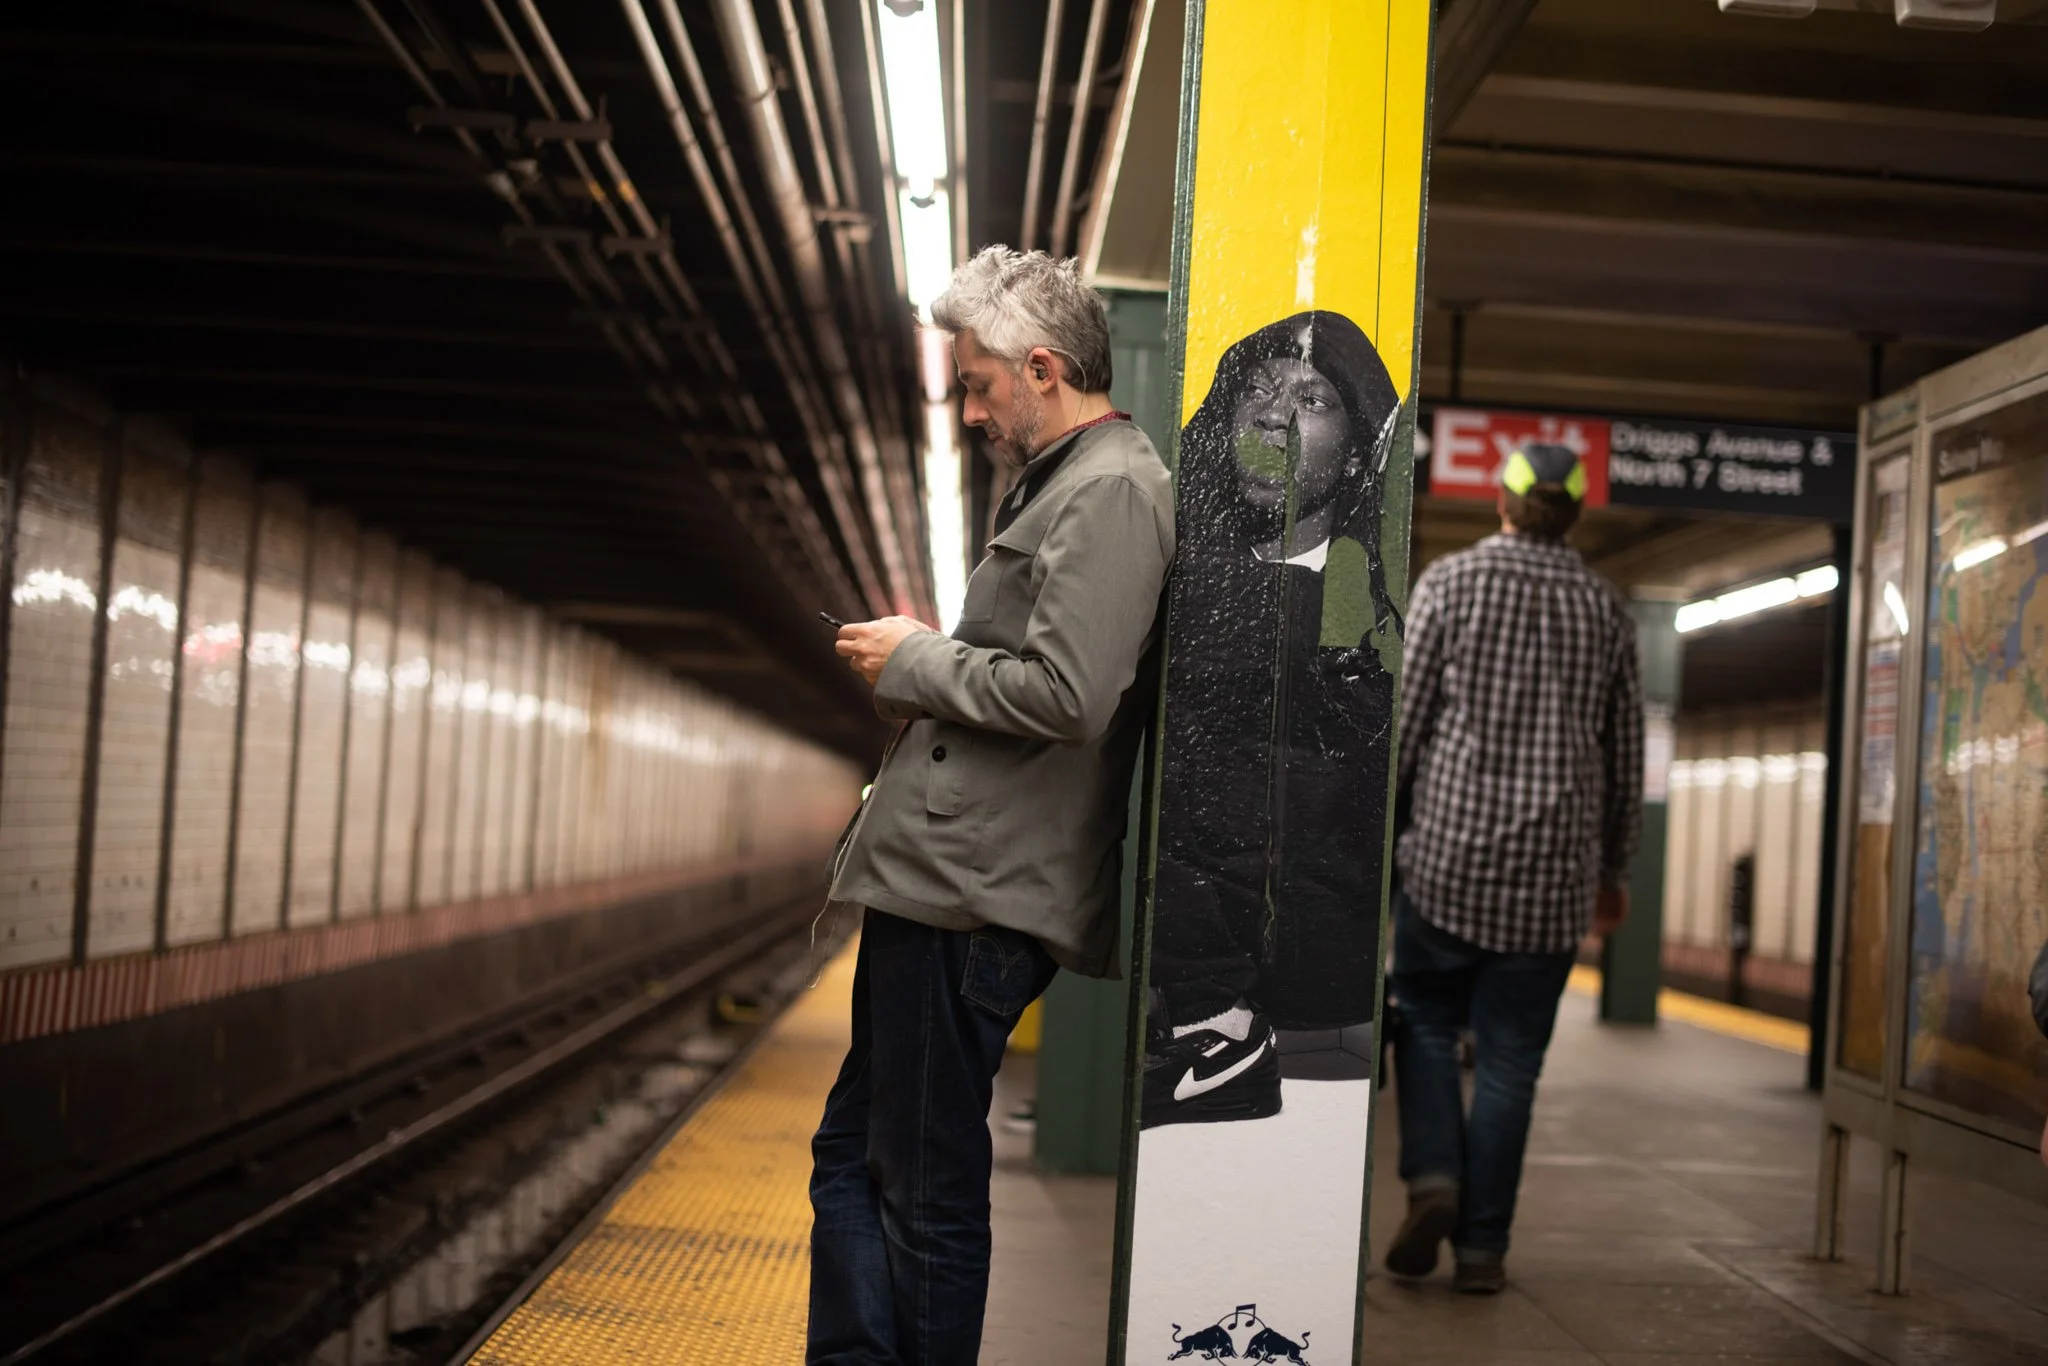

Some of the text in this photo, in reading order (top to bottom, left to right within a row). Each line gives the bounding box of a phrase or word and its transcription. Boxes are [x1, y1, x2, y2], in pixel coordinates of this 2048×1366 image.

[1610, 421, 1834, 466] Driggs Avenue &
[1608, 453, 1803, 496] North 7 Street
